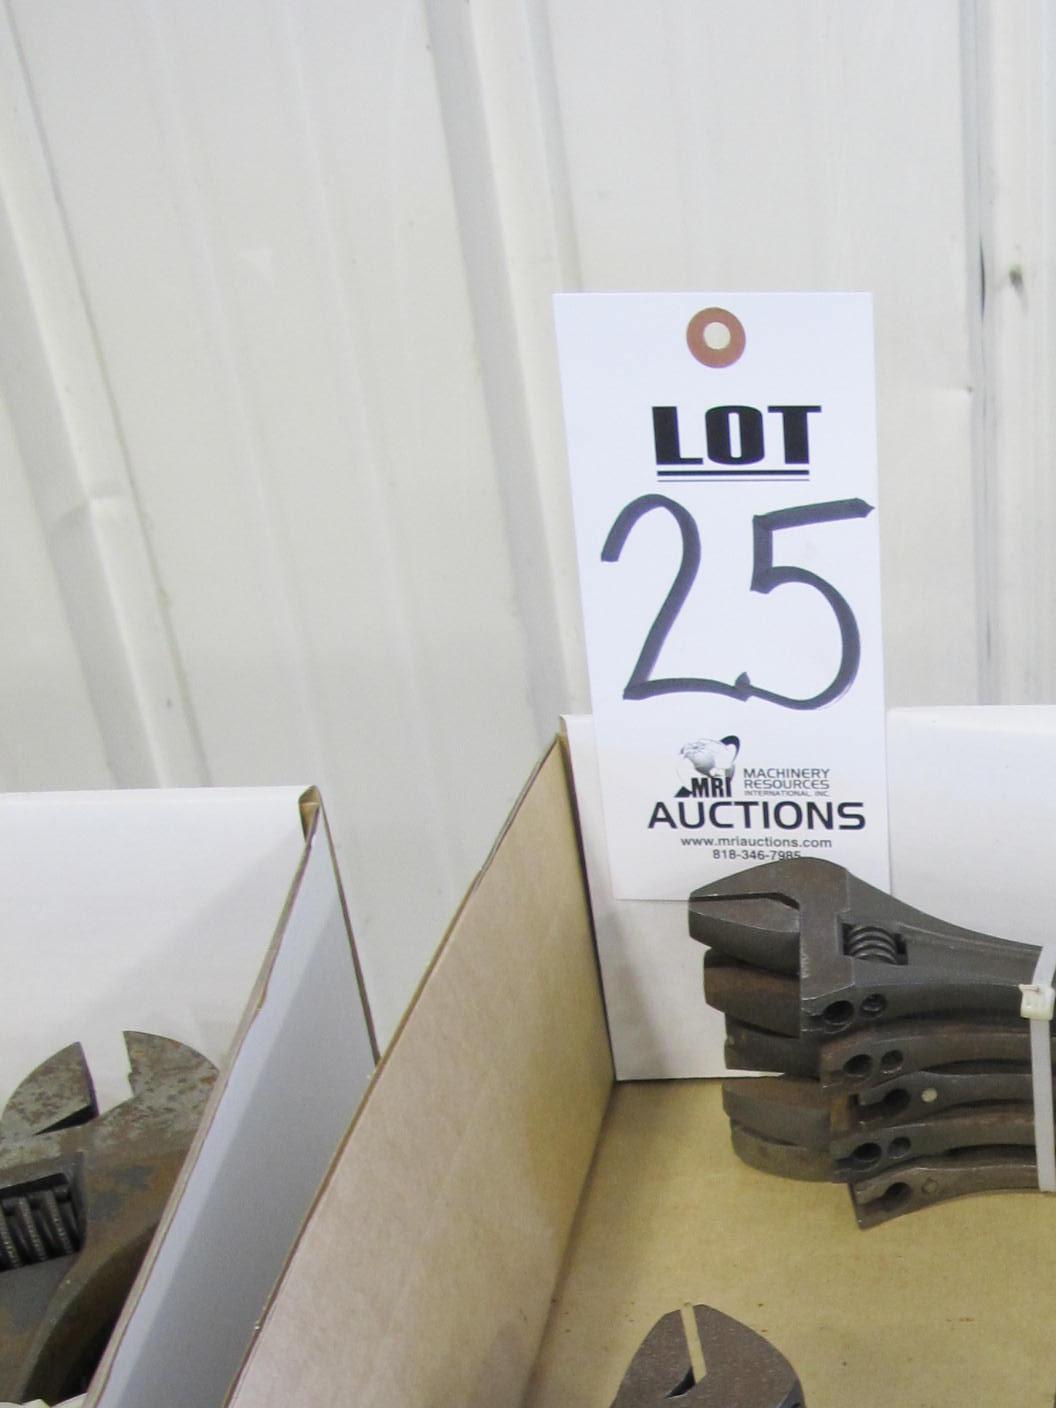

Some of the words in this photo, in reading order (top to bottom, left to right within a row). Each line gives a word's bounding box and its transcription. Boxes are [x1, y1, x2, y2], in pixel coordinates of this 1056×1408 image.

[652, 405, 822, 466] LOT
[601, 493, 875, 710] 25
[743, 768, 830, 779] MACHINERY
[691, 776, 732, 798] MRI
[744, 779, 830, 790] RESOURCES
[648, 801, 866, 830] AUCTIONS
[680, 836, 832, 848] www.mriauctions.com
[713, 849, 801, 861] 818-346-7985
